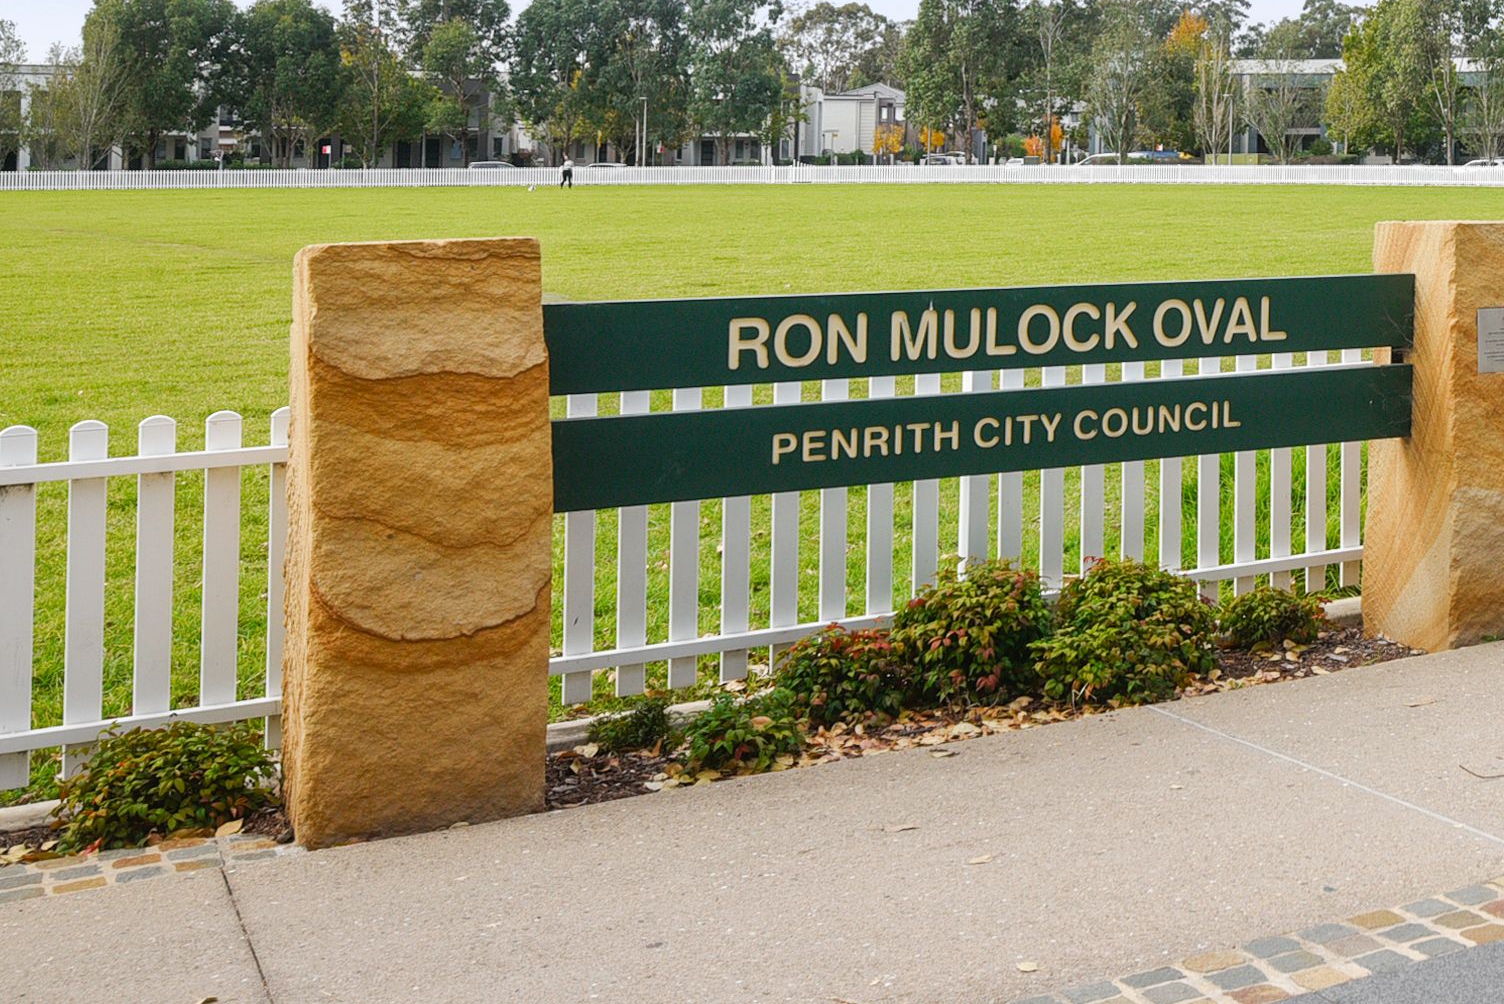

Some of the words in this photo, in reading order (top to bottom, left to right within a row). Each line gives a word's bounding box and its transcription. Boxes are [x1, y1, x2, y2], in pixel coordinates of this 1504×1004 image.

[728, 311, 869, 370] RON
[891, 301, 1139, 362] MULOCK
[1153, 296, 1288, 347] OVAL
[771, 419, 960, 465] PENRITH
[973, 412, 1063, 449] CITY
[1073, 399, 1242, 441] COUNCIL
